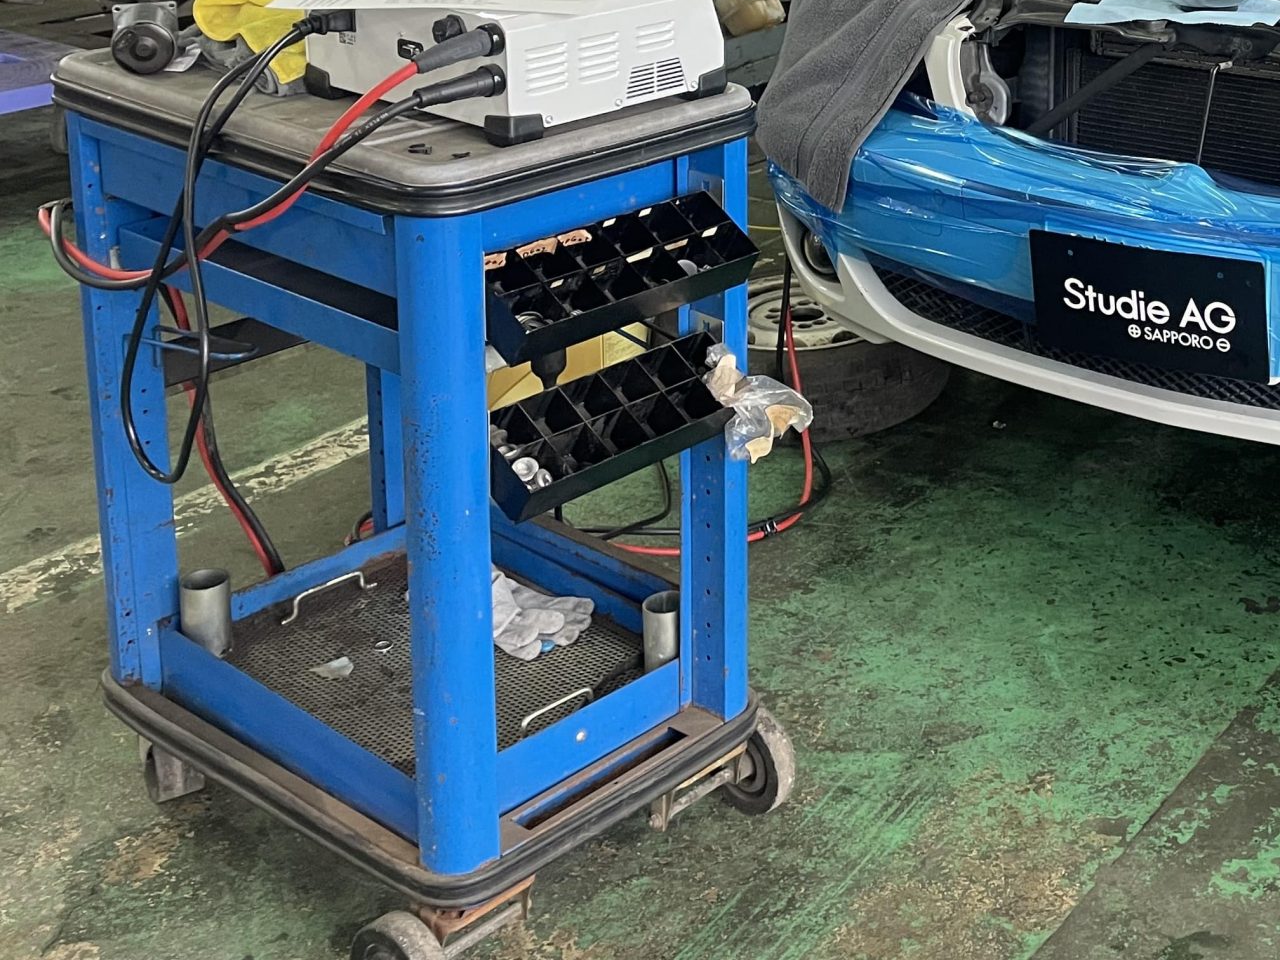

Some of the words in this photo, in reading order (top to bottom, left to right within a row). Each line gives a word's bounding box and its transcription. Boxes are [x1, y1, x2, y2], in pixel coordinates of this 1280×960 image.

[1063, 277, 1171, 325] Studie
[1179, 297, 1237, 335] AG
[1143, 326, 1214, 350] SAPPORO
